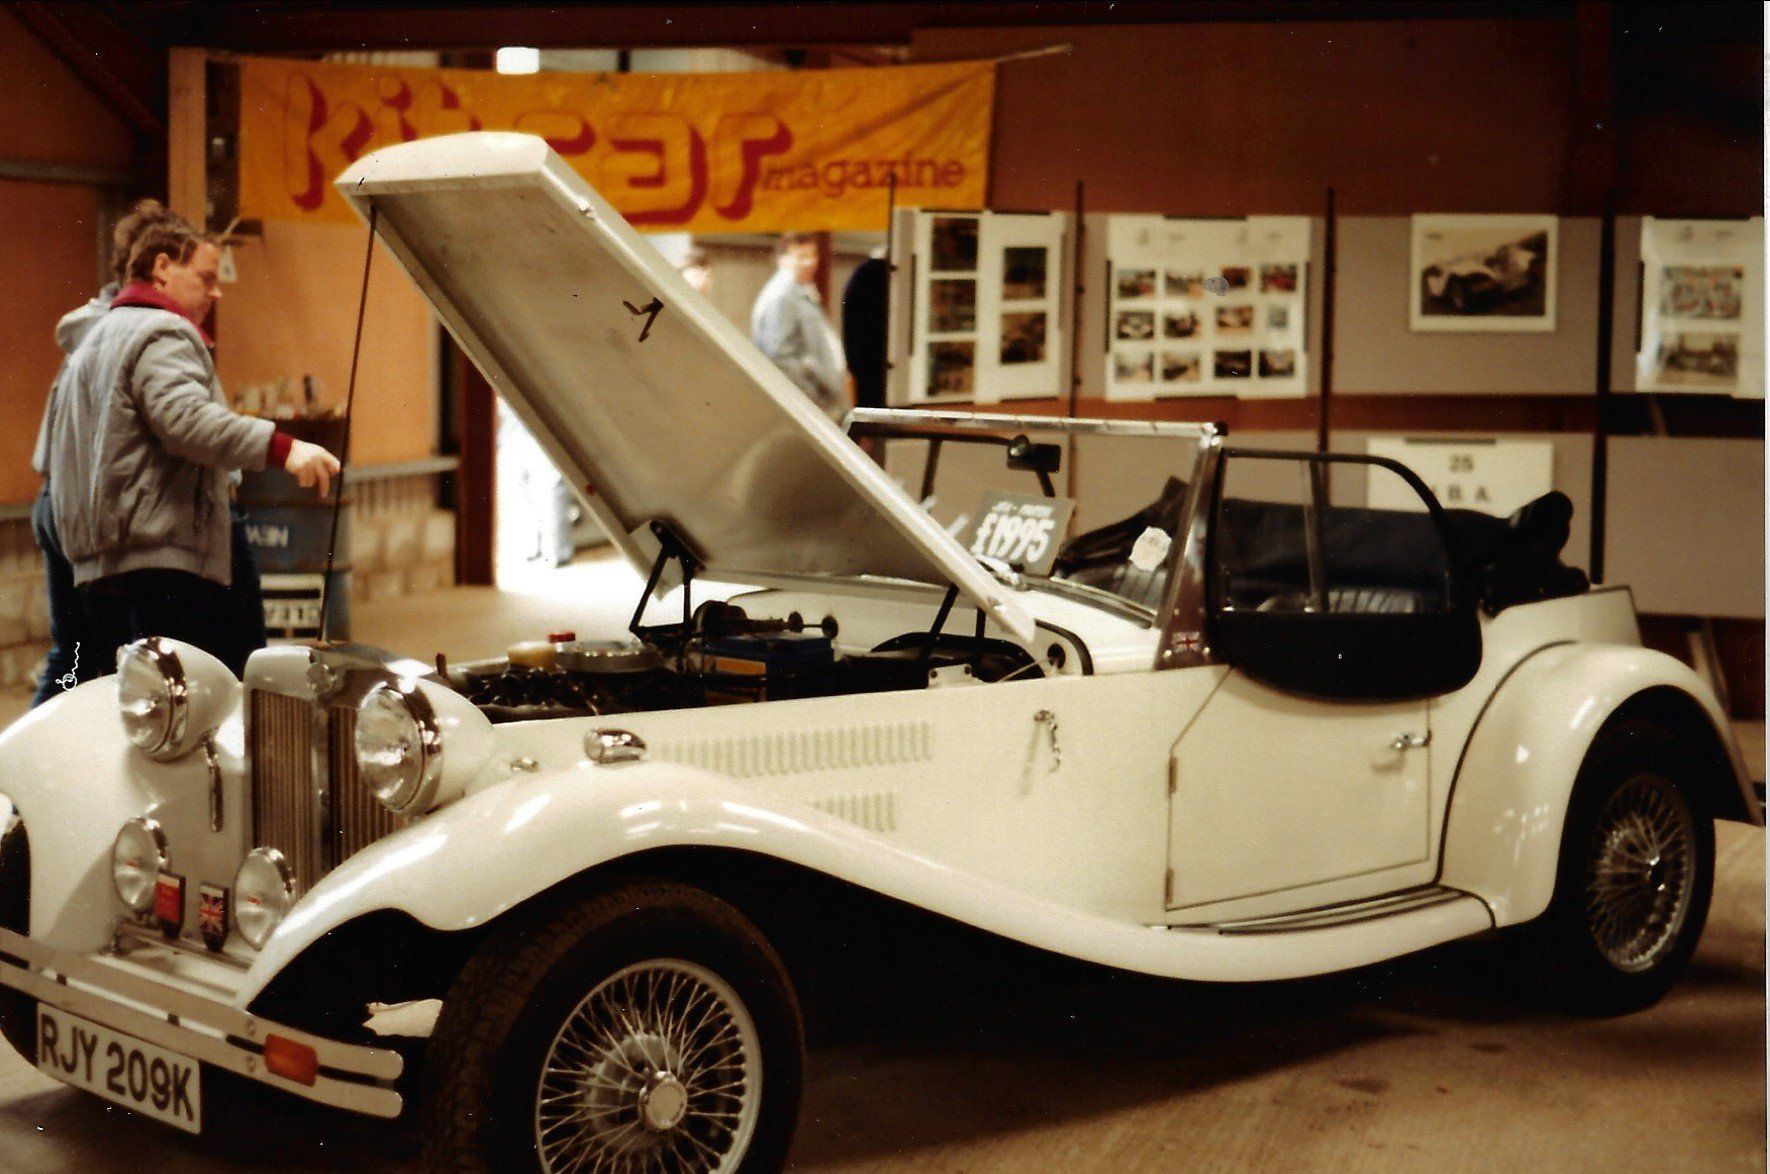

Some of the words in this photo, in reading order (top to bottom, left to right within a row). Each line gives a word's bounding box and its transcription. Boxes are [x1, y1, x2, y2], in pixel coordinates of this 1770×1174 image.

[760, 153, 966, 197] magazine
[970, 512, 1056, 563] £1995
[40, 1013, 98, 1082] RJY
[106, 1041, 194, 1122] 209K
